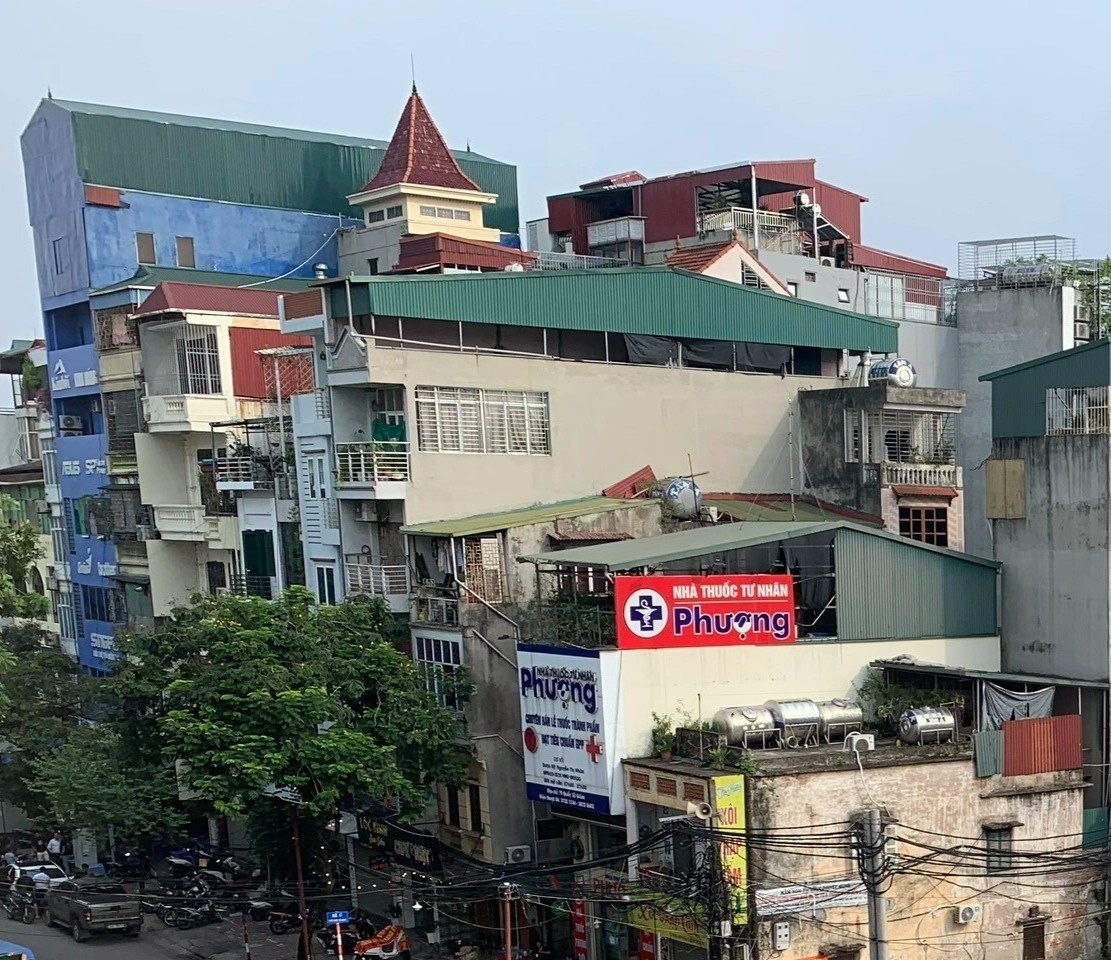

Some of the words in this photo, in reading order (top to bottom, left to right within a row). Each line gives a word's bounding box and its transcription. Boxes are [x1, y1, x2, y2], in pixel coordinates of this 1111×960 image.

[673, 583, 698, 599] NHÀ
[700, 580, 738, 598] THUỐC
[740, 582, 756, 597] TƯ
[757, 581, 788, 597] NHÂN
[673, 605, 791, 640] Phượng
